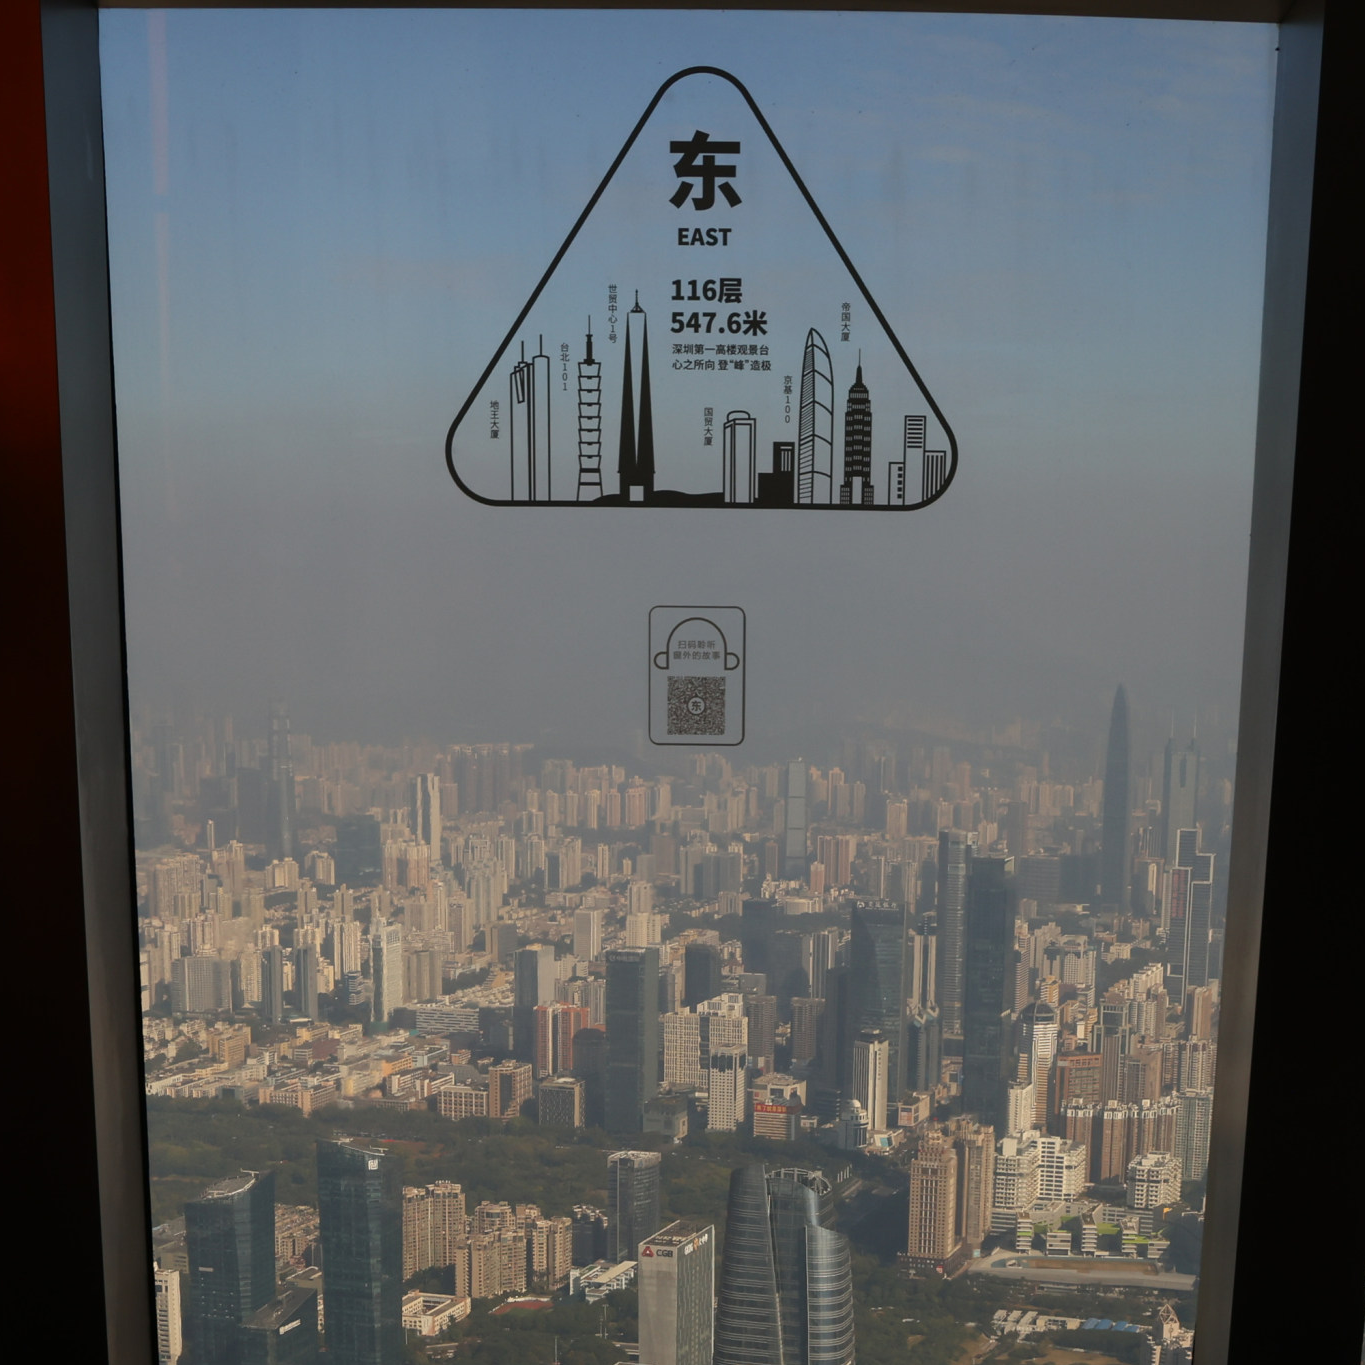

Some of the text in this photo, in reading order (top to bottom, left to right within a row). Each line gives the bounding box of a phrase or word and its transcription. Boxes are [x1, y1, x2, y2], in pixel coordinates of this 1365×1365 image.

[670, 130, 743, 211] 东
[678, 227, 732, 246] EAST
[671, 278, 742, 303] 116层
[608, 284, 618, 343] 世贸中心1号
[670, 309, 768, 336] 547.6米
[841, 302, 851, 342] 帝国大厦
[672, 344, 770, 356] 深圳第一高楼观景台
[560, 342, 570, 391] 台北101
[672, 359, 715, 371] 心之所向
[783, 375, 793, 424] 京基100
[490, 400, 500, 439] 地王大厦
[704, 407, 714, 447] 国贸大厦
[678, 640, 716, 649] 扫码聆听
[691, 700, 702, 712] 东
[656, 1248, 674, 1258] CGB
